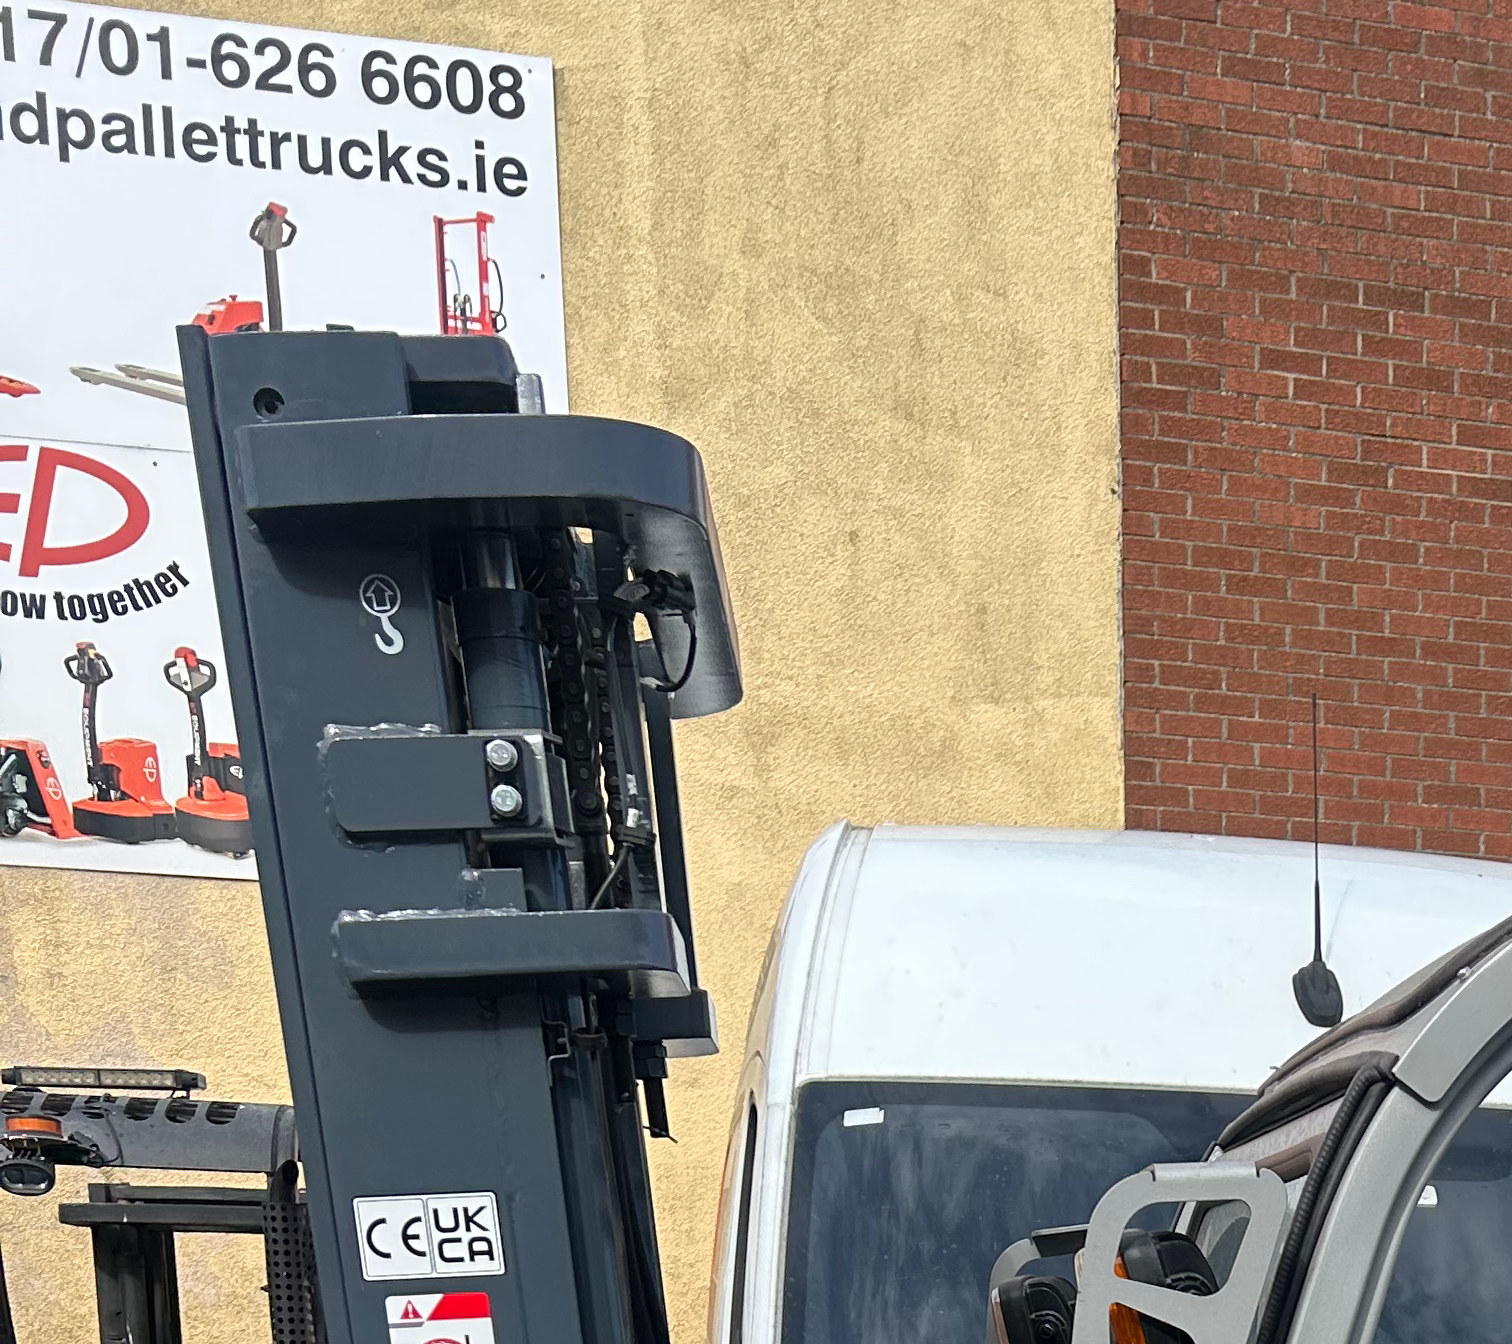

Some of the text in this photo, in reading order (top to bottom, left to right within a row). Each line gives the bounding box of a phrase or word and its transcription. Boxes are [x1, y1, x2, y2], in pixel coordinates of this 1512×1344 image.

[360, 49, 526, 120] 6608
[0, 90, 528, 198] dpallettrucks.ie
[53, 559, 191, 624] together
[432, 1205, 490, 1234] UK
[438, 1236, 495, 1264] CA
